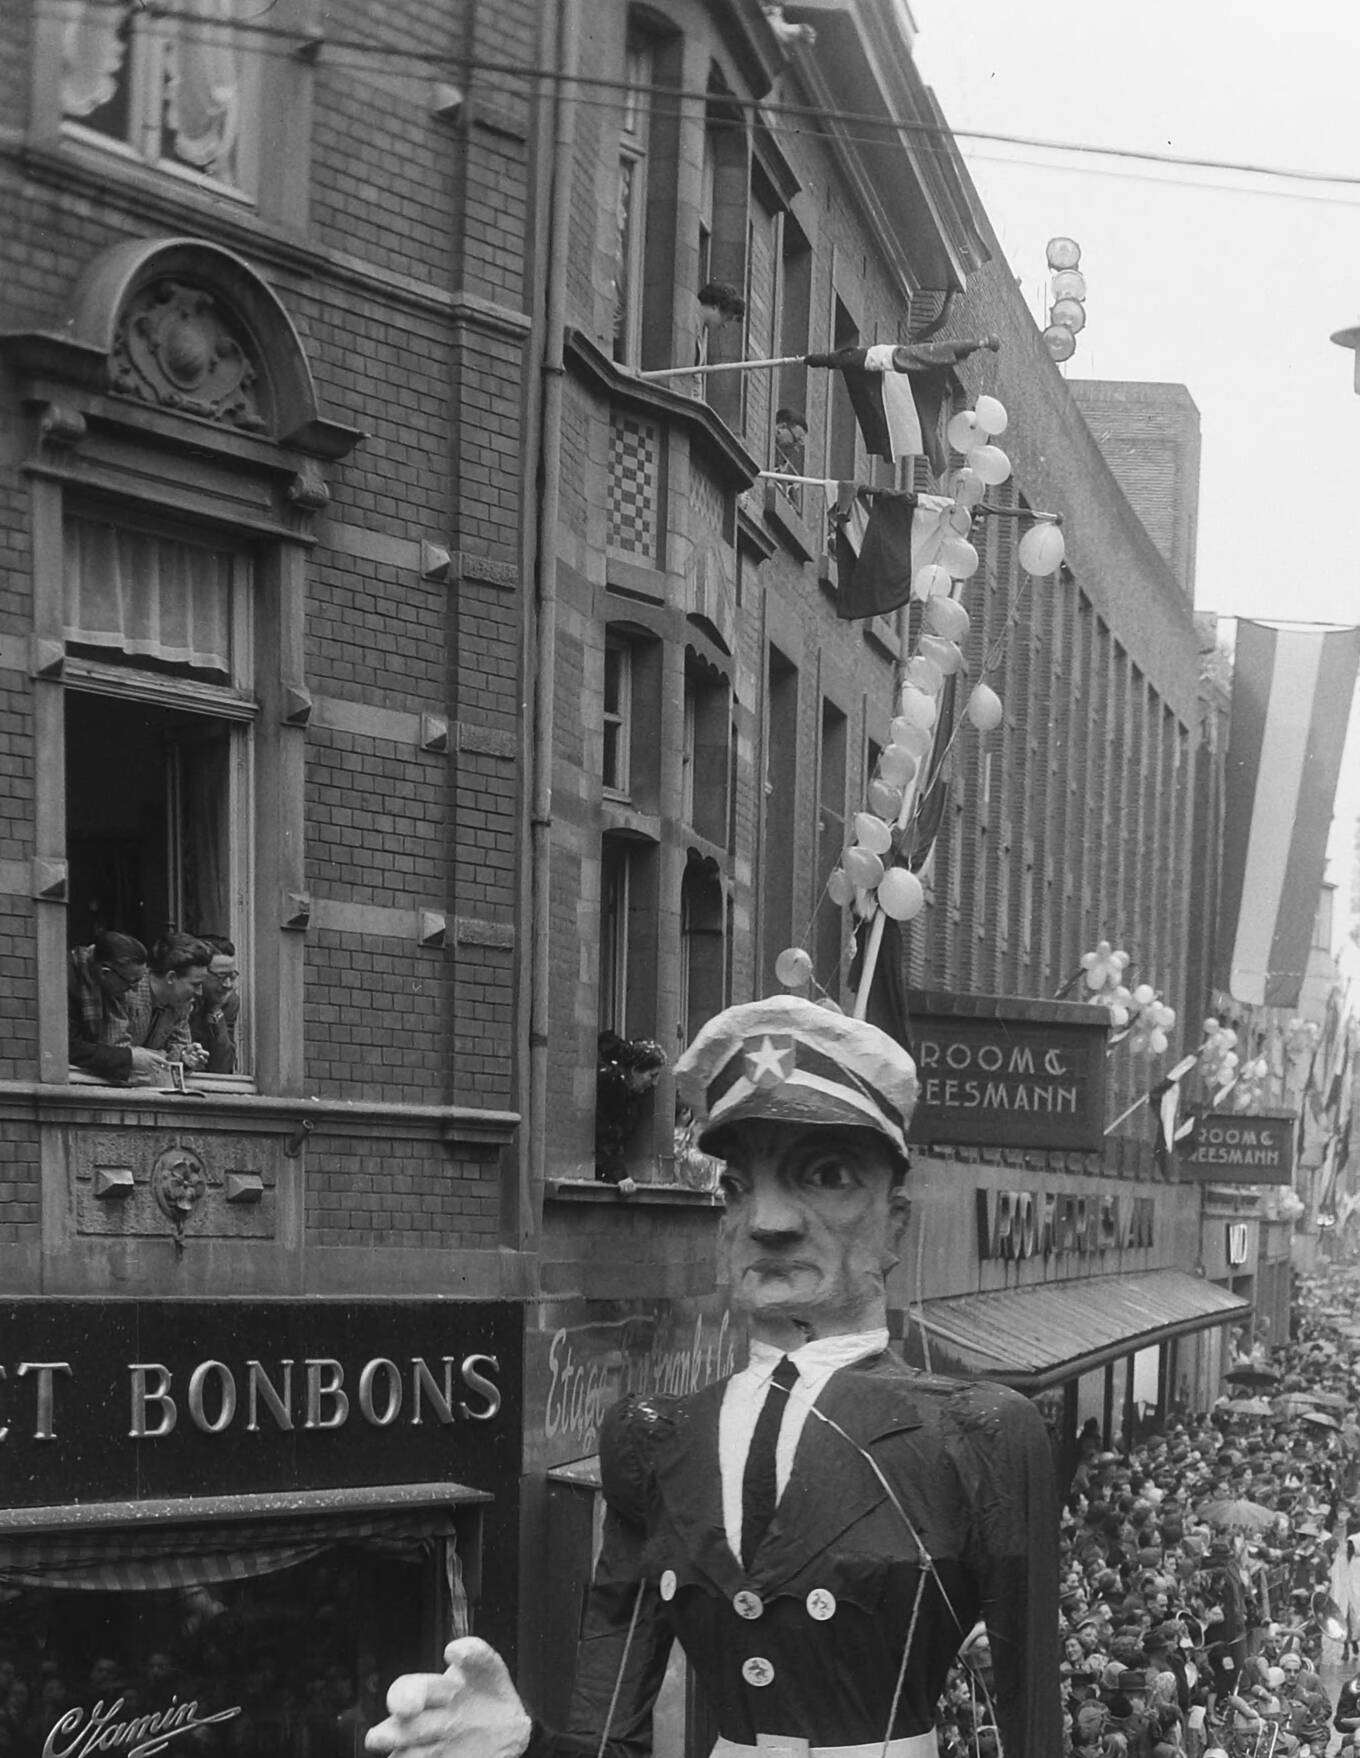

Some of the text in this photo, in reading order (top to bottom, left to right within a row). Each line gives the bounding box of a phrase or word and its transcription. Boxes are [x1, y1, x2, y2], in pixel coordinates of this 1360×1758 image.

[912, 1041, 1036, 1074] ROOM
[924, 1078, 1078, 1113] EESMANN
[0, 1353, 503, 1441] T BONBONS
